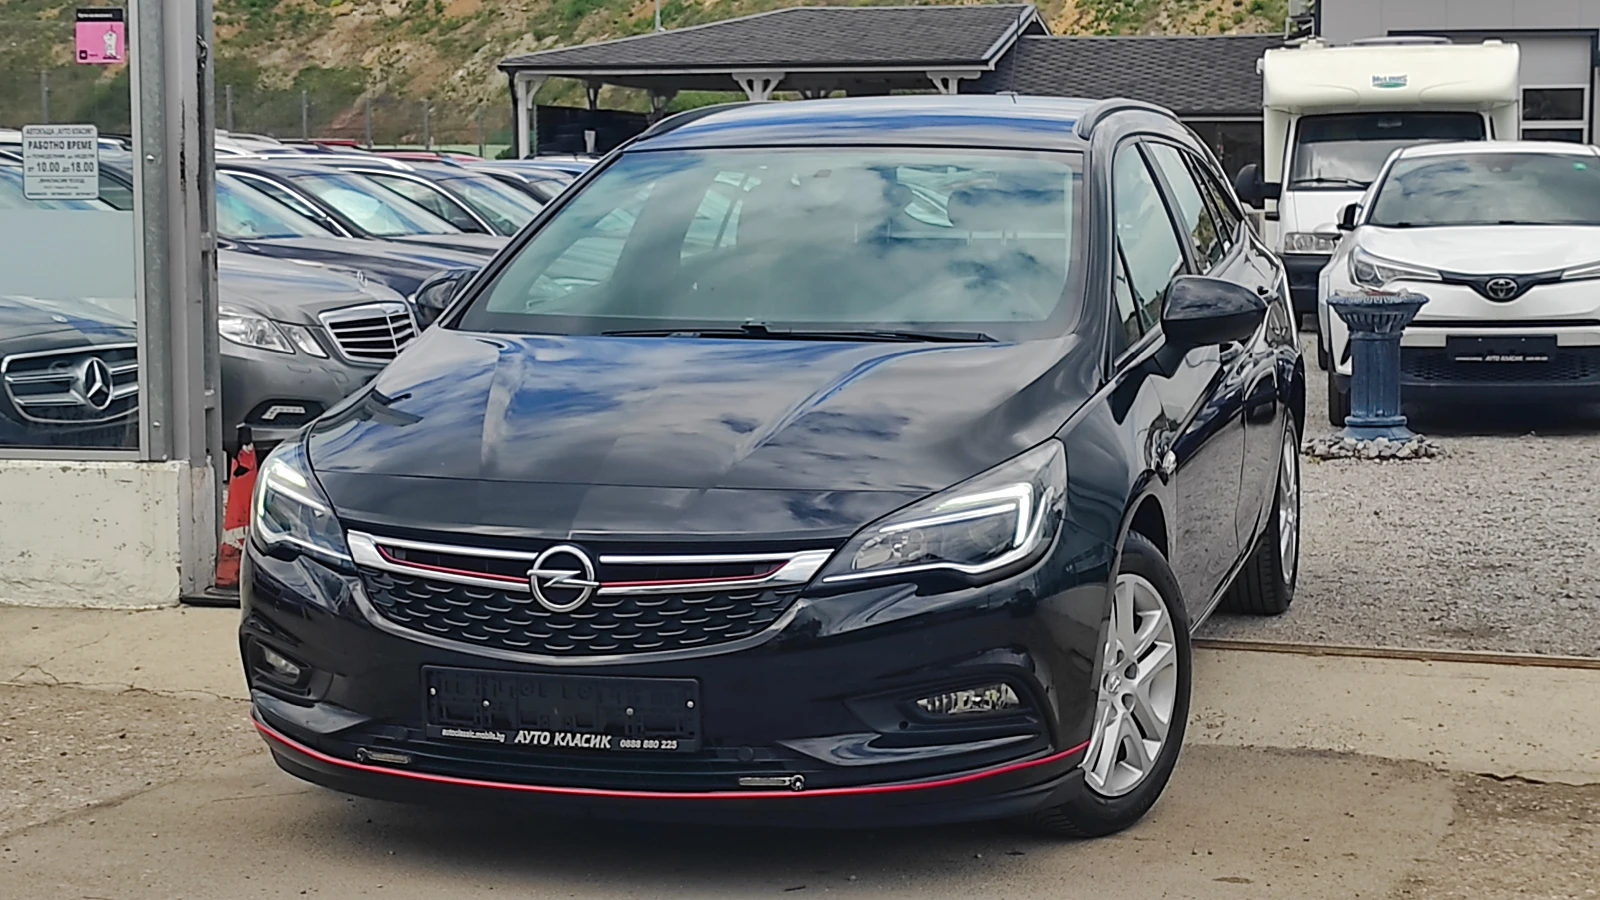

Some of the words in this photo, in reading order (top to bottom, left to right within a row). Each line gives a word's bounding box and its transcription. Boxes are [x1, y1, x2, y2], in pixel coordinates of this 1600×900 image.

[28, 140, 65, 150] РАБОТНО
[67, 140, 92, 150] ВРЕМЕ
[36, 161, 60, 172] 10.00
[71, 161, 94, 172] 18.00
[514, 730, 551, 745] АУТО
[554, 732, 612, 749] КЛАСИК
[660, 740, 678, 750] 225
